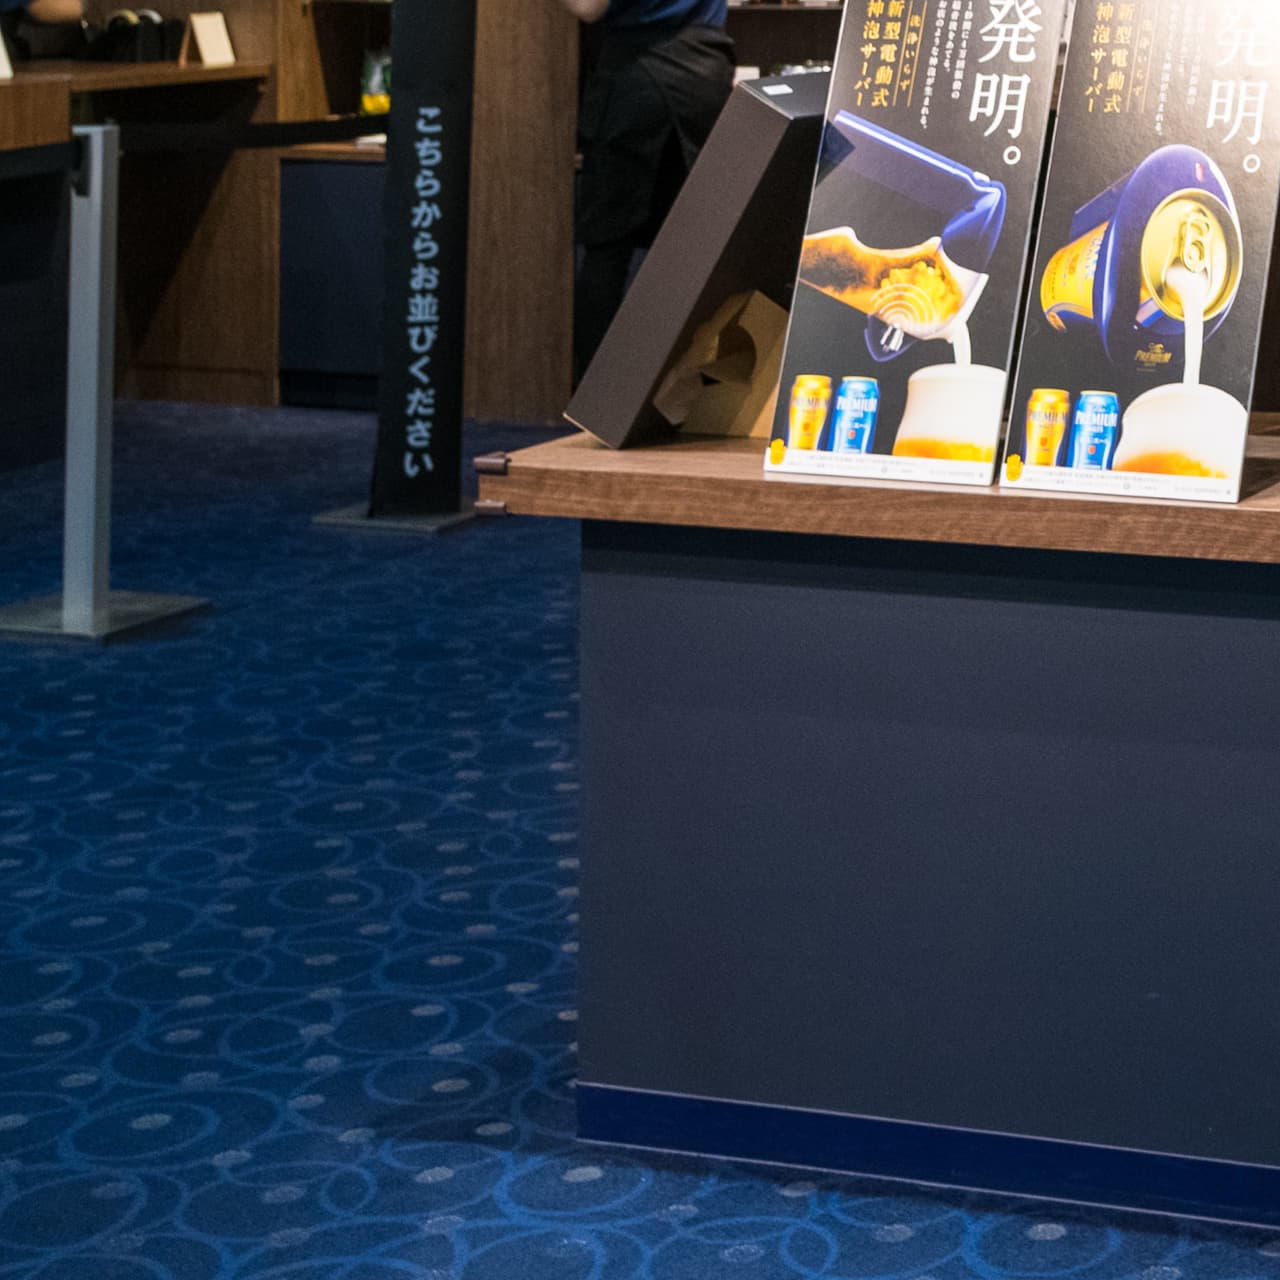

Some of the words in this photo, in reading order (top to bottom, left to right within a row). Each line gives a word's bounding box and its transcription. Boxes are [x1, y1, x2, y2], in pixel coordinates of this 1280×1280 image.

[871, 0, 906, 108] 新型電動式
[1084, 1, 1114, 114] 神泡サーバー
[1103, 2, 1136, 114] 新型電動式
[405, 106, 443, 480] こちらからお並びください
[836, 396, 879, 412] PREMIUM
[1074, 411, 1119, 428] PREMIUM
